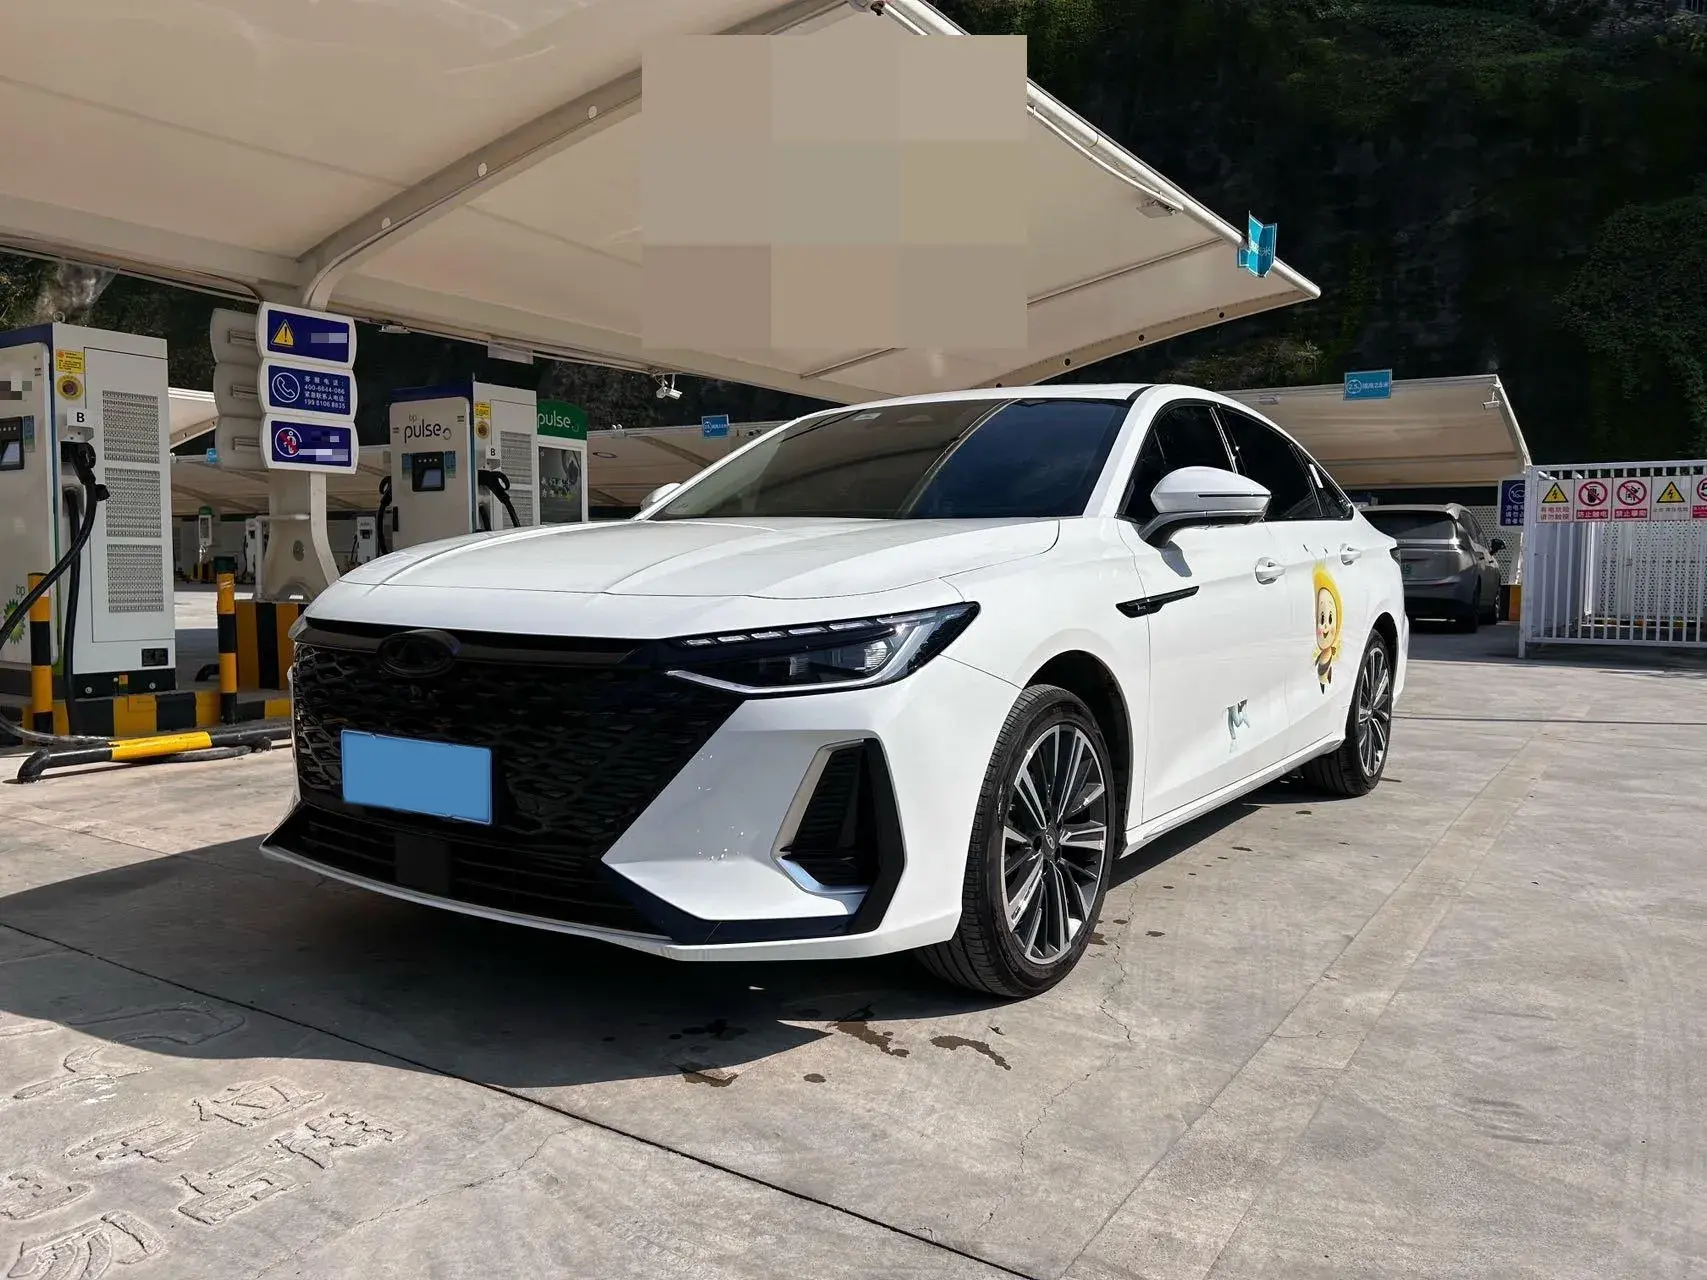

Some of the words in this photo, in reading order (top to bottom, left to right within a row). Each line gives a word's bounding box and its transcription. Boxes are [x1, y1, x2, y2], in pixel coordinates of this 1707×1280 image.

[76, 412, 85, 423] B
[537, 410, 571, 429] pulse
[404, 418, 442, 444] pulse
[490, 447, 496, 456] B
